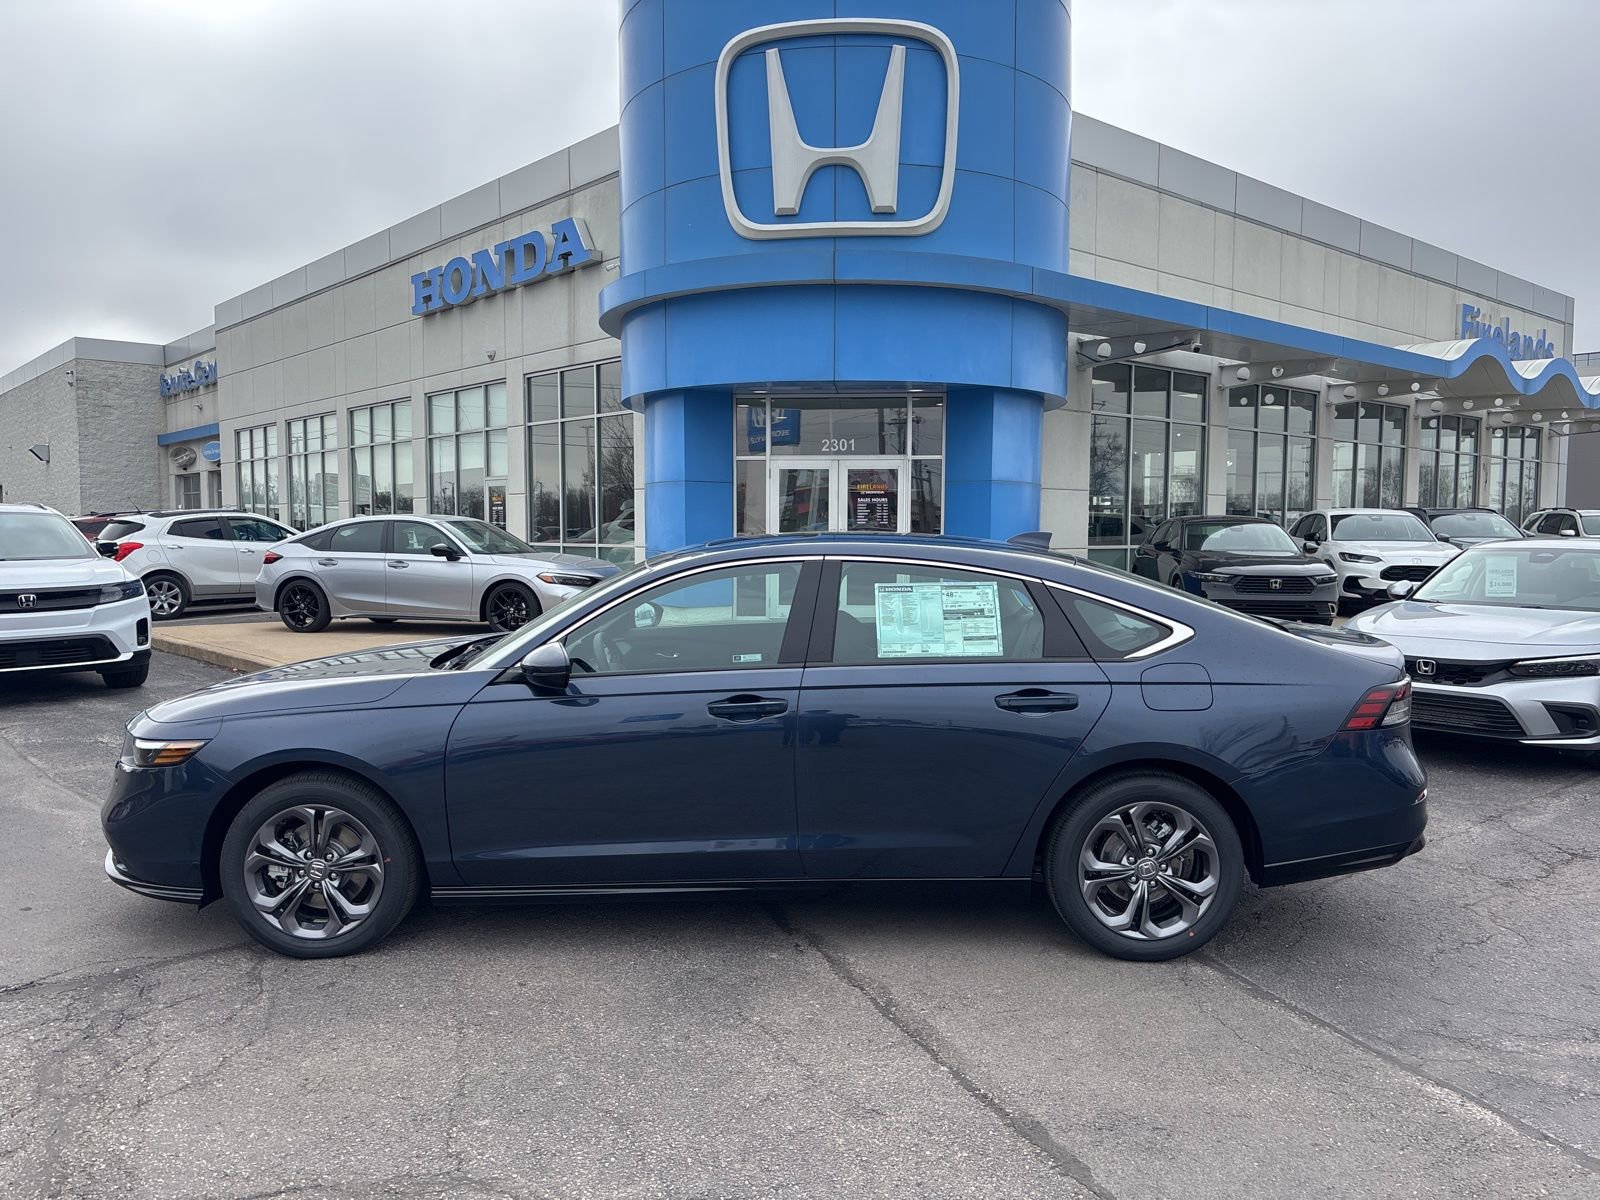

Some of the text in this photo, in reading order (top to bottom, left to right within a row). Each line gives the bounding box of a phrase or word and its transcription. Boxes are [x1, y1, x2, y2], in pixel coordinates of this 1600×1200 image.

[411, 217, 595, 316] HONDA
[1460, 303, 1555, 360] Firelands
[821, 438, 855, 452] 2301
